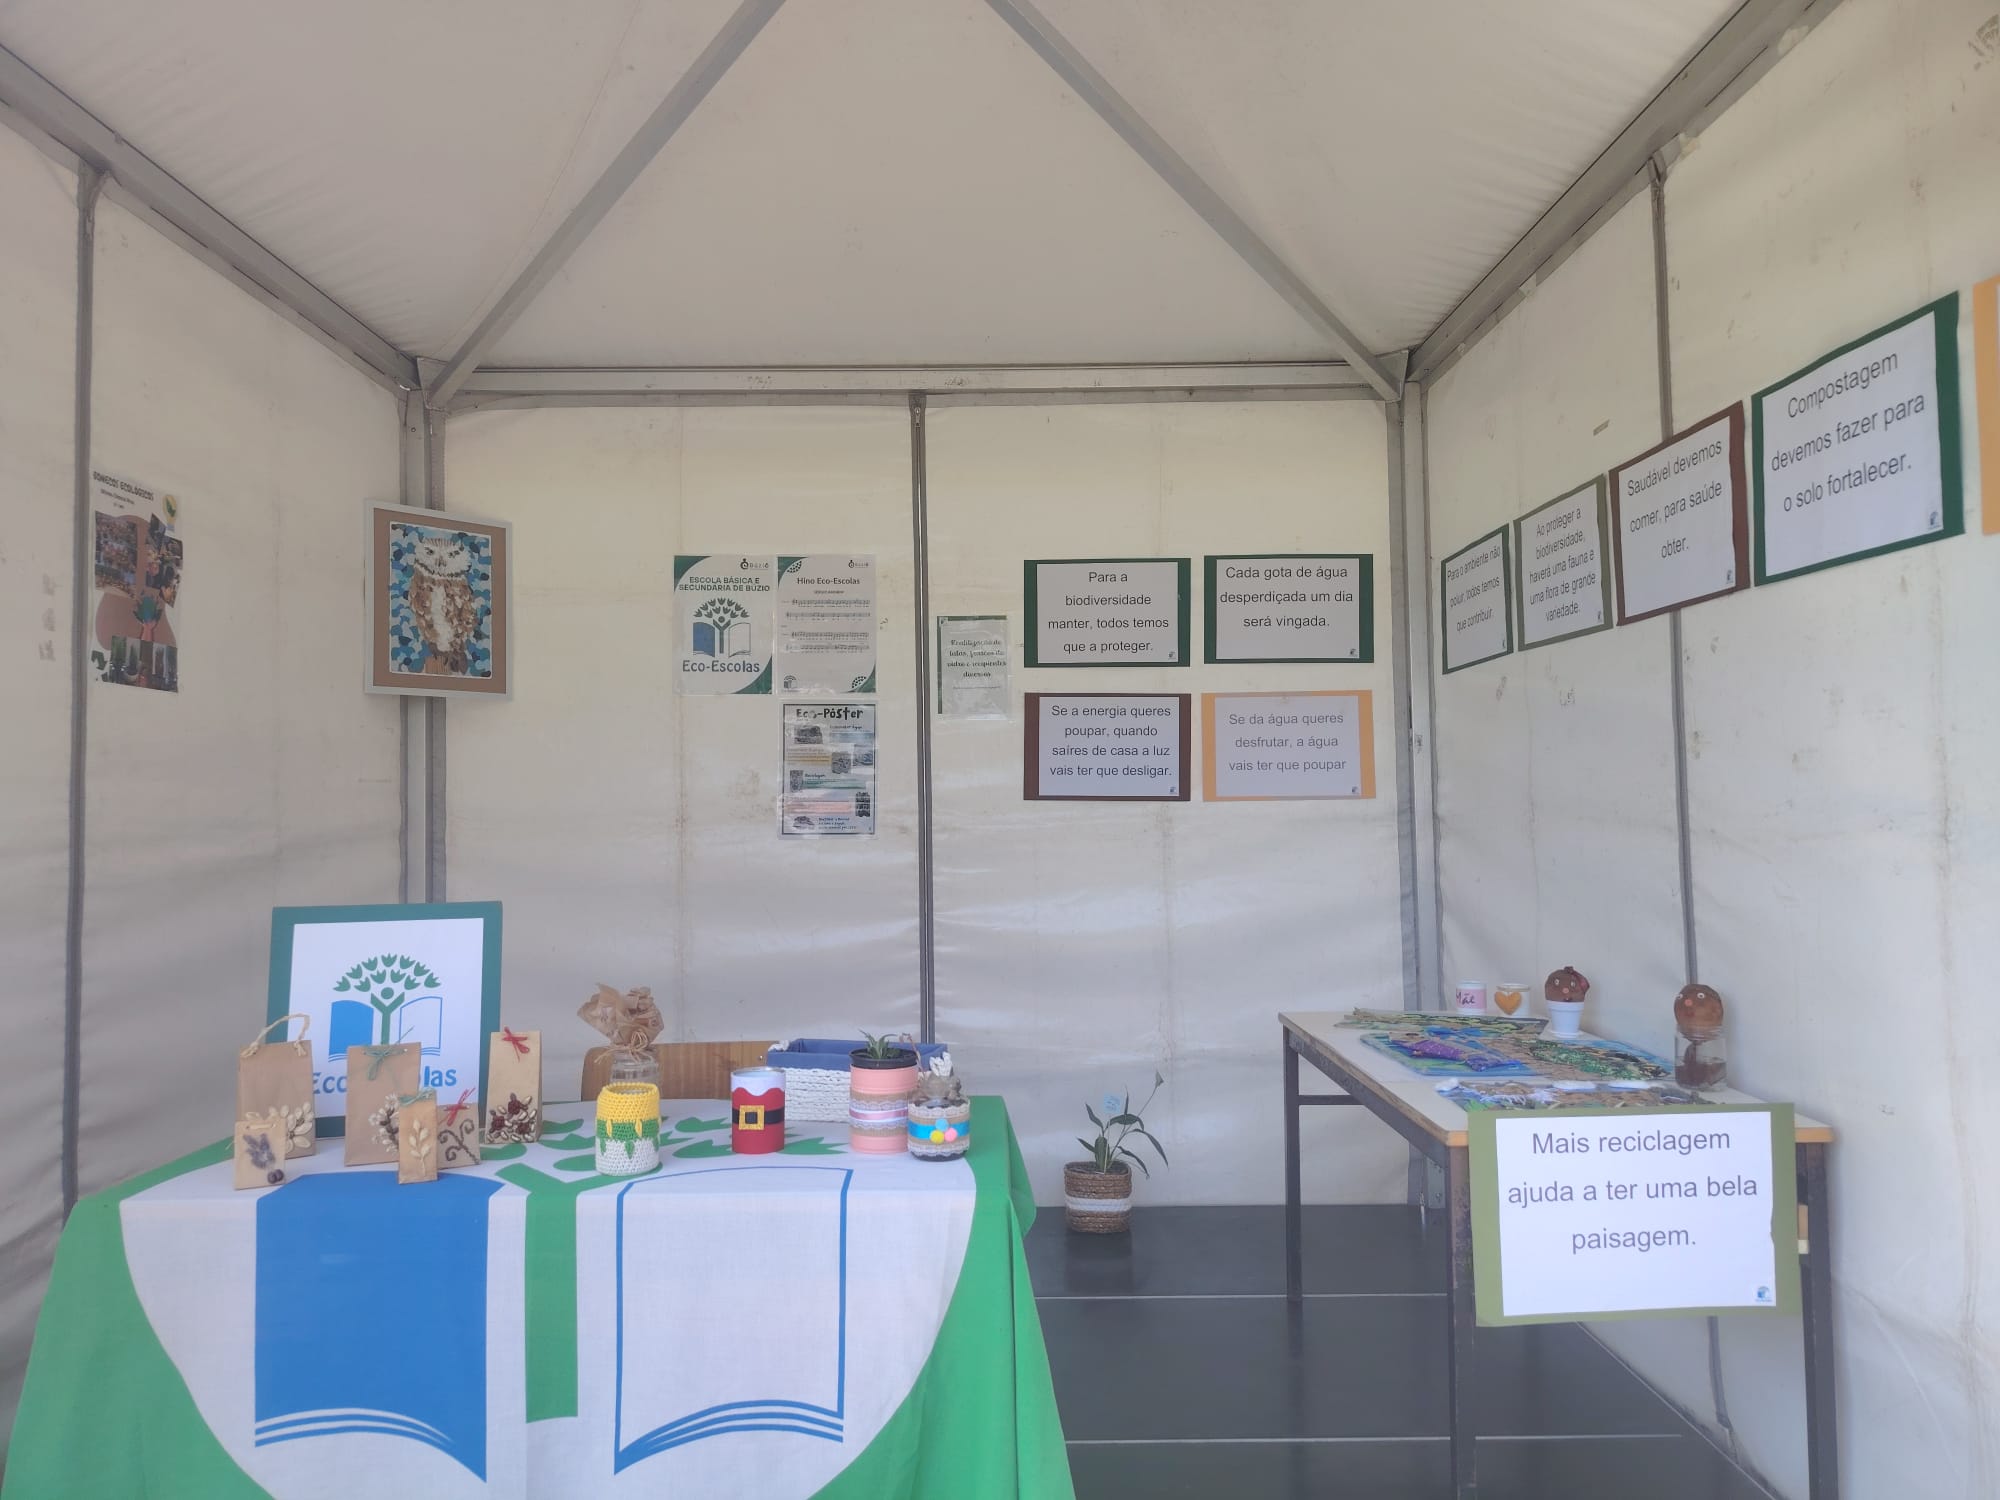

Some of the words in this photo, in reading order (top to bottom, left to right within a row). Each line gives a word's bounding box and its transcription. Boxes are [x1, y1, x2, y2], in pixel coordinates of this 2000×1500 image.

[1788, 353, 1898, 418] Compostagem
[1772, 432, 1832, 471] devemos
[1836, 413, 1878, 444] fazer
[1884, 395, 1925, 431] para
[1627, 461, 1671, 496] Saudável
[1674, 440, 1722, 475] devemos
[1783, 496, 1792, 512] o
[1796, 482, 1823, 508] solo
[1827, 453, 1912, 497] fortalecer.
[1630, 509, 1662, 533] comer,
[1664, 497, 1686, 523] para
[1689, 481, 1722, 507] saúde
[1536, 524, 1545, 536] Ao
[1546, 510, 1574, 537] proteger
[1576, 508, 1581, 519] a
[1661, 537, 1689, 559] obter.
[1447, 569, 1459, 582] Para
[1464, 552, 1489, 575] ambiente
[1489, 546, 1501, 560] não
[1529, 566, 1551, 584] haverá
[1552, 560, 1567, 575] uma
[1568, 552, 1588, 569] fauna
[1589, 549, 1595, 561] e
[690, 576, 721, 584] ESCOLA
[724, 575, 753, 584] BÁSICA
[1088, 571, 1117, 583] Para
[1120, 573, 1128, 582] a
[1225, 566, 1260, 578] Cada
[1263, 566, 1292, 580] gota
[1296, 566, 1312, 578] de
[1316, 566, 1348, 580] água
[736, 584, 743, 592] DE
[797, 577, 815, 585] Hino
[817, 577, 860, 585] Eco-Escolas
[1466, 584, 1480, 601] todos
[1481, 576, 1500, 592] temos
[1530, 591, 1544, 605] uma
[1545, 586, 1559, 601] flora
[1560, 581, 1570, 595] de
[1571, 572, 1596, 595] grande
[1065, 594, 1152, 606] biodiversidade
[1220, 591, 1306, 605] desperdiçada
[1311, 592, 1330, 602] um
[1334, 590, 1353, 602] dia
[1048, 619, 1093, 630] manter,
[1097, 617, 1129, 628] todos
[1133, 617, 1169, 628] temos
[1243, 616, 1272, 627] será
[1276, 615, 1330, 629] vingada.
[1456, 619, 1466, 633] que
[1063, 642, 1086, 654] que
[1089, 642, 1097, 652] a
[1101, 641, 1153, 653] proteger.
[682, 660, 760, 673] Eco-Escolas
[1051, 705, 1068, 716] Se
[1071, 707, 1079, 716] a
[1082, 706, 1127, 718] energia
[1130, 706, 1171, 718] queres
[1229, 713, 1245, 724] Se
[1249, 713, 1264, 724] da
[1268, 713, 1298, 727] água
[1302, 714, 1344, 725] queres
[1065, 727, 1110, 738] poupar,
[1113, 725, 1158, 738] quando
[1235, 737, 1292, 749] desfrutar,
[1296, 738, 1304, 747] a
[1307, 736, 1339, 749] água
[1092, 745, 1107, 756] de
[1110, 746, 1138, 756] casa
[1142, 747, 1149, 756] a
[1153, 745, 1170, 756] luz
[1050, 765, 1074, 776] vais
[1077, 765, 1093, 776] ter
[1096, 767, 1119, 778] que
[1122, 765, 1172, 778] desligar.
[1229, 760, 1253, 771] vais
[1257, 760, 1272, 770] ter
[1276, 761, 1299, 773] que
[1303, 760, 1347, 772] poupar
[1532, 1132, 1590, 1154] Mais
[1599, 1130, 1730, 1155] reciclagem
[1508, 1181, 1574, 1208] ajuda
[1583, 1184, 1597, 1200] a
[1606, 1180, 1638, 1200] ter
[1646, 1180, 1698, 1199] uma
[1707, 1175, 1758, 1197] bela
[1572, 1228, 1696, 1255] paisagem.
